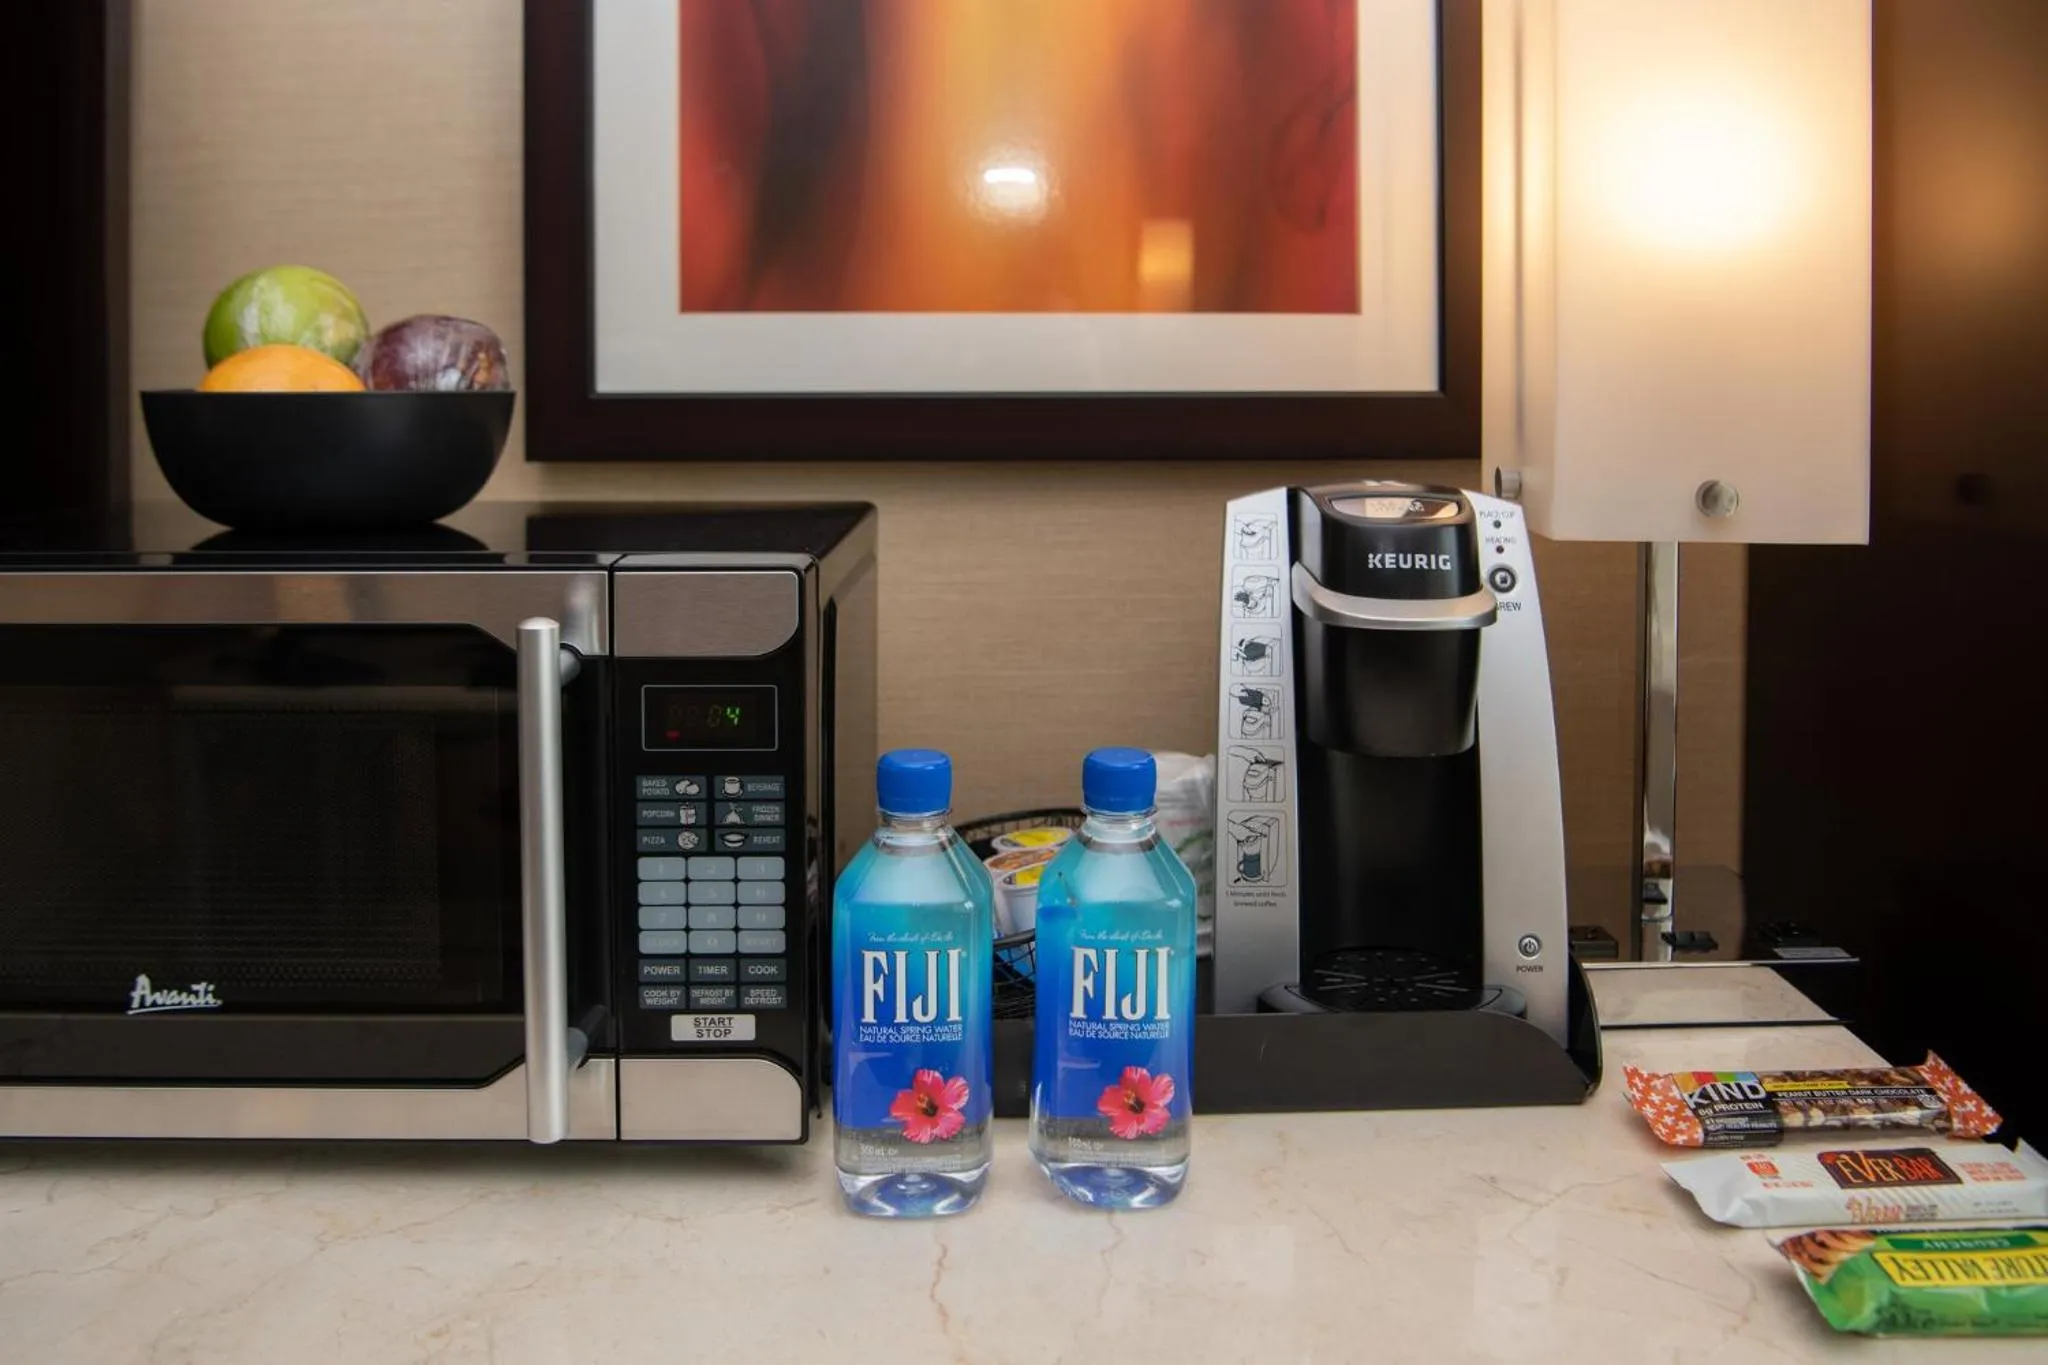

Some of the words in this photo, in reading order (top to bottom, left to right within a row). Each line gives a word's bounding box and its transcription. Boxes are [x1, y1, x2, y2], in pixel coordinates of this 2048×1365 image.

[1368, 552, 1452, 571] KEURIG
[1496, 601, 1522, 612] REW
[642, 836, 666, 845] PIZZA
[643, 965, 681, 975] POWER
[698, 965, 729, 975] TIMER
[748, 965, 778, 975] COOK
[861, 948, 962, 1024] FIJI
[1069, 946, 1171, 1021] FIJI
[129, 974, 218, 1009] Avanti
[643, 989, 668, 998] COOK
[645, 997, 678, 1006] WEIGHT
[693, 1016, 735, 1027] START
[696, 1028, 733, 1039] STOP
[860, 1025, 897, 1035] NATURAL
[1684, 1080, 1767, 1109] KIND
[1813, 1090, 1848, 1098] BUTTER
[1714, 1102, 1764, 1114] PROTEIN
[1923, 1238, 2011, 1250] CRUNCHY
